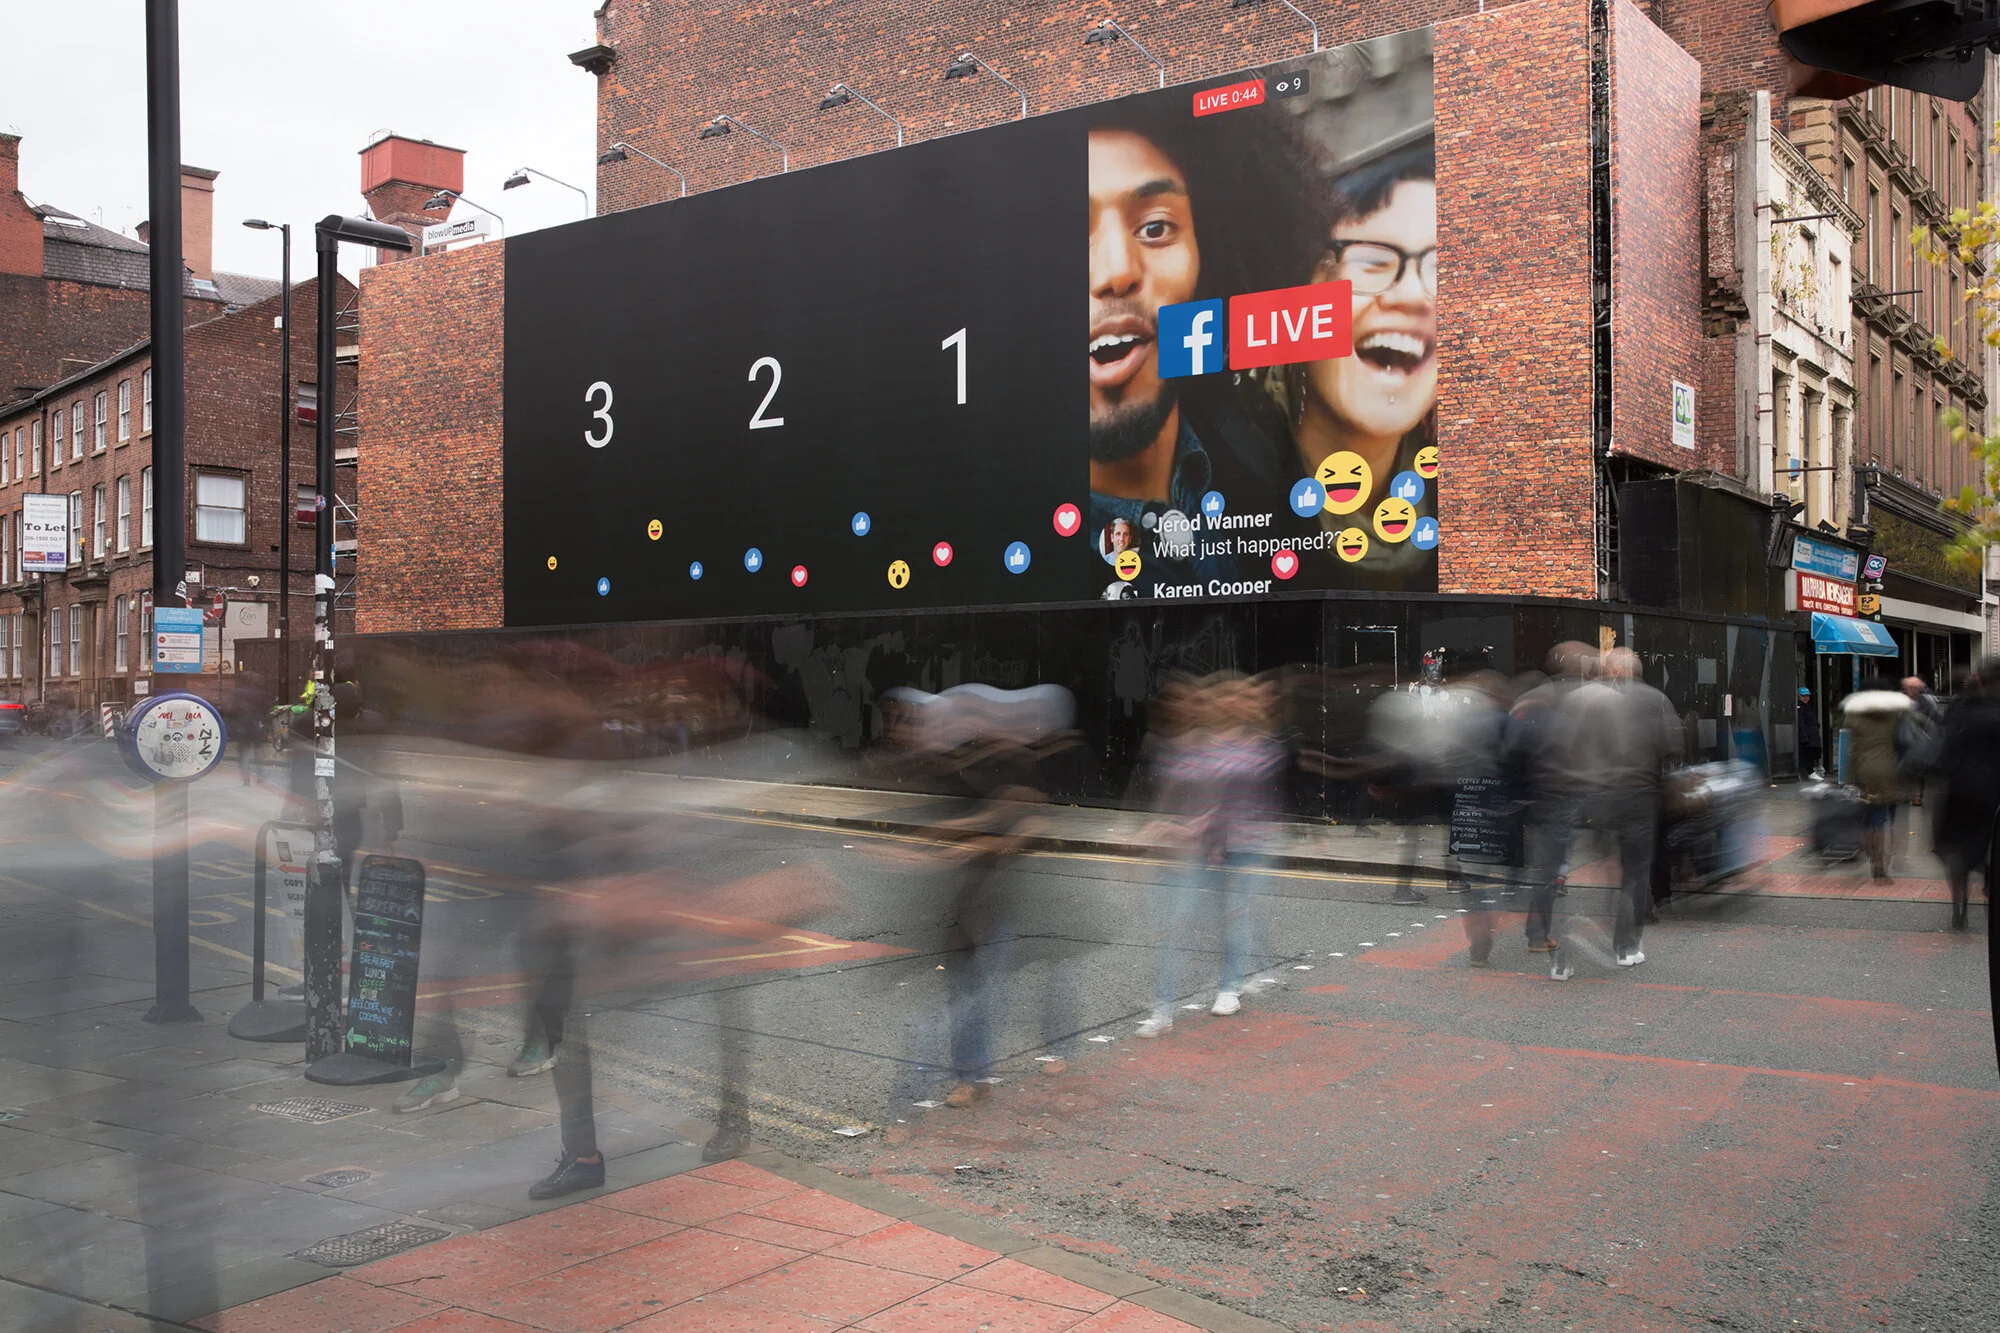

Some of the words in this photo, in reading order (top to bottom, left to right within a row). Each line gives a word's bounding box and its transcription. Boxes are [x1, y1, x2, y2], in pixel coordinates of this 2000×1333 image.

[1293, 77, 1301, 90] 9
[1199, 93, 1228, 111] LIVE
[1231, 86, 1258, 104] 0:44
[1247, 303, 1333, 348] LIVE
[1183, 310, 1214, 375] f
[584, 380, 614, 449] 3
[748, 356, 785, 430] 2
[941, 327, 967, 405] 1
[24, 523, 41, 531] To
[45, 523, 66, 532] Let
[1152, 513, 1201, 534] Jerod
[1206, 512, 1273, 531] Wanner
[1153, 537, 1197, 559] What
[1199, 537, 1232, 561] just
[1153, 583, 1203, 599] Karen
[1826, 581, 1854, 606] NEWSAGENT
